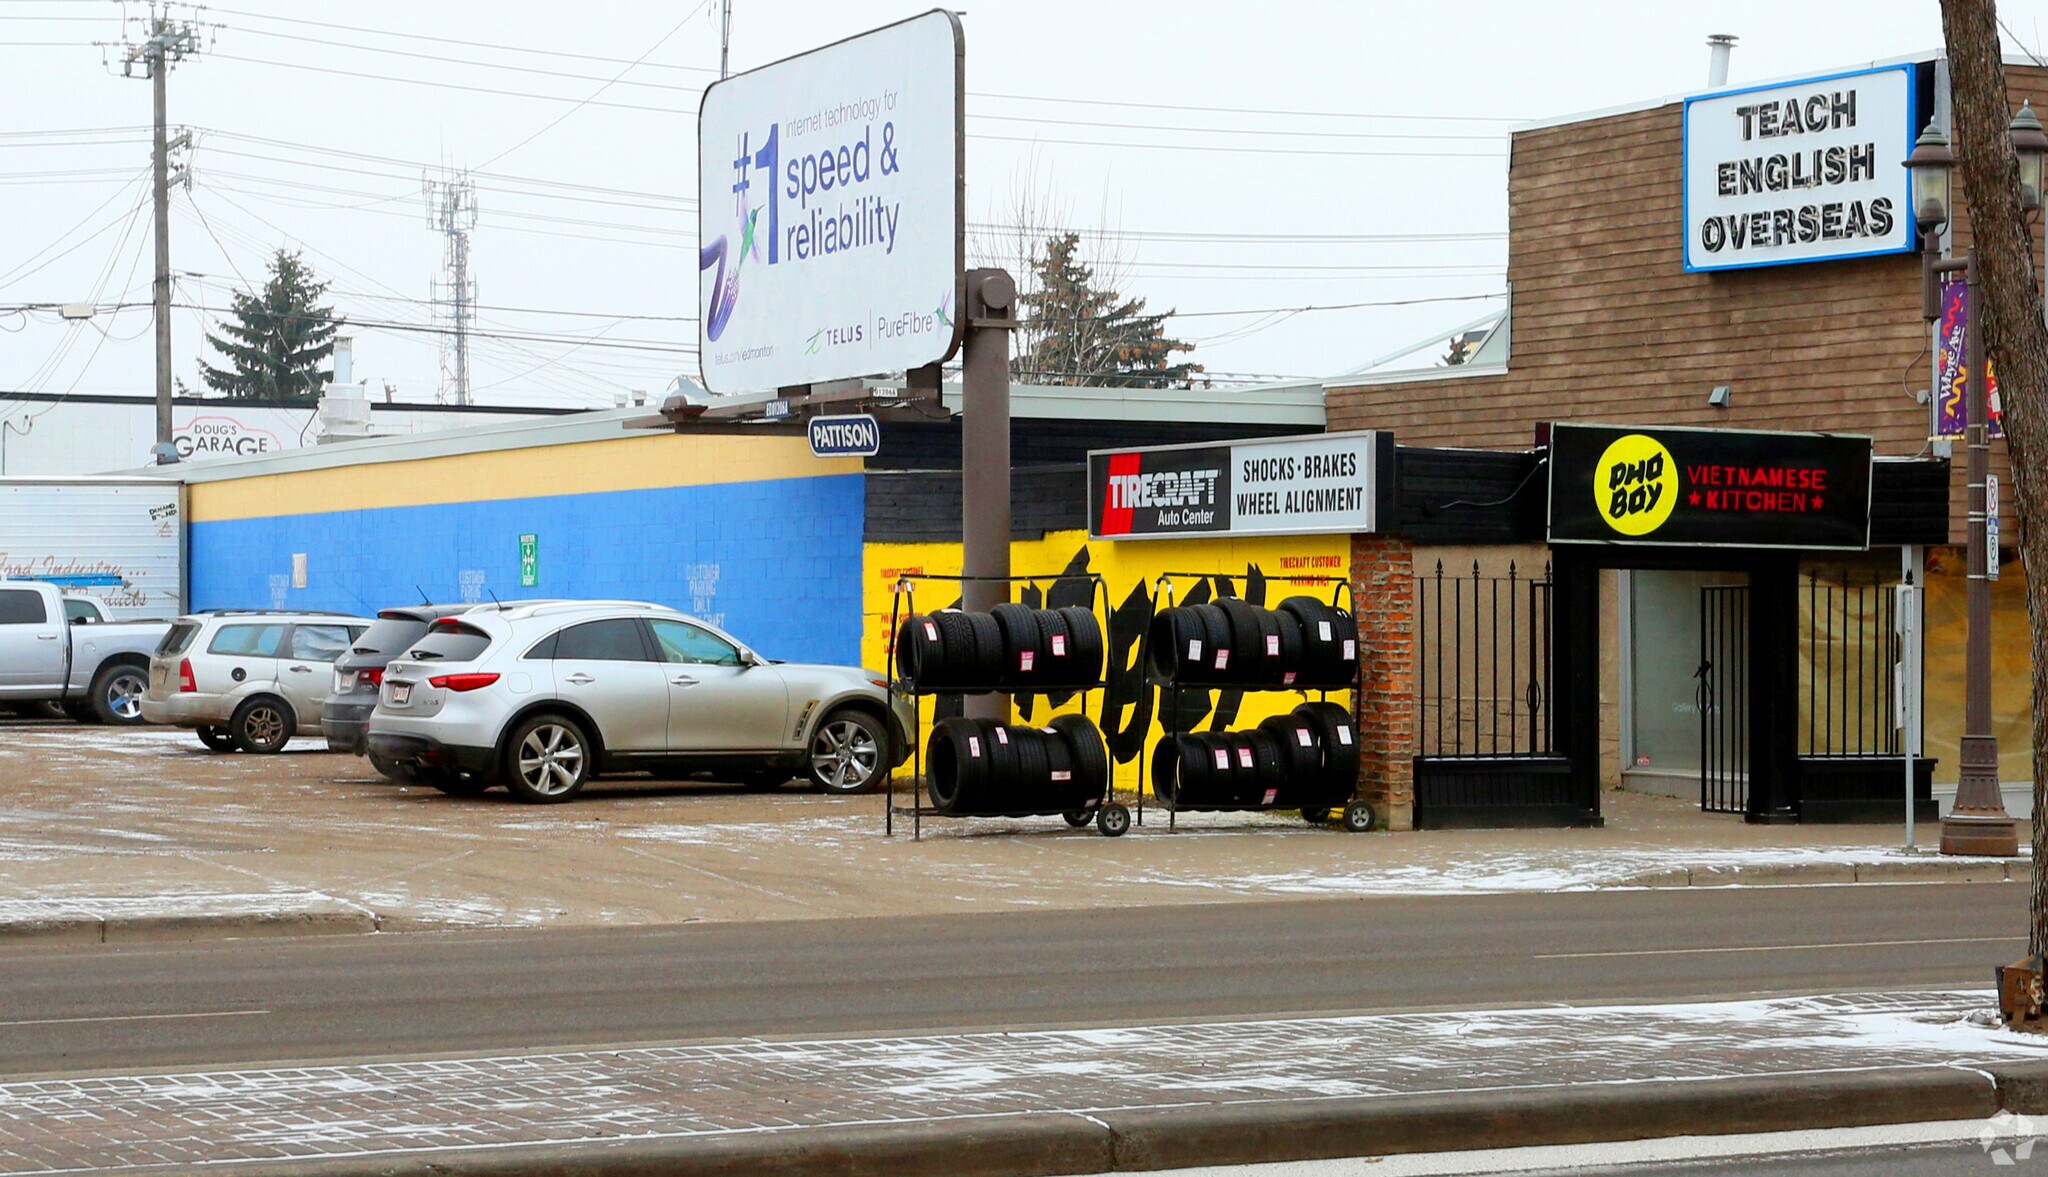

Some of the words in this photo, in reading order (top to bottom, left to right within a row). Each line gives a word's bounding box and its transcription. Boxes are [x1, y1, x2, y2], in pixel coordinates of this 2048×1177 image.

[785, 110, 822, 138] internet
[824, 97, 882, 130] technology
[883, 91, 898, 112] for
[1735, 90, 1857, 141] TEACH
[786, 124, 871, 209] speed
[880, 121, 899, 175] &
[1717, 143, 1875, 197] ENGLISH
[732, 122, 779, 265] #1
[787, 196, 899, 263] reliability
[1701, 197, 1893, 253] OVERSEAS
[826, 324, 863, 346] TELUS
[878, 309, 933, 340] PureFibre
[1940, 350, 1958, 400] Whyte
[1949, 325, 1962, 352] Ave
[173, 435, 268, 458] GARAGE
[194, 424, 237, 435] DOUG'S
[813, 422, 874, 449] PATTISON
[1243, 457, 1294, 483] SHOCKS
[1304, 453, 1356, 479] BRAKES
[1609, 452, 1664, 490] PHO
[1688, 464, 1827, 490] VIETNAMESE
[1109, 468, 1220, 510] TIRECRAFT
[1237, 491, 1280, 516] WHEEL
[1285, 486, 1363, 514] ALIGNMENT
[1609, 482, 1664, 520] BOY
[1706, 490, 1806, 513] KITCHEN
[1158, 509, 1180, 527] Auto
[1182, 508, 1214, 525] Center
[43, 554, 122, 576] Industry
